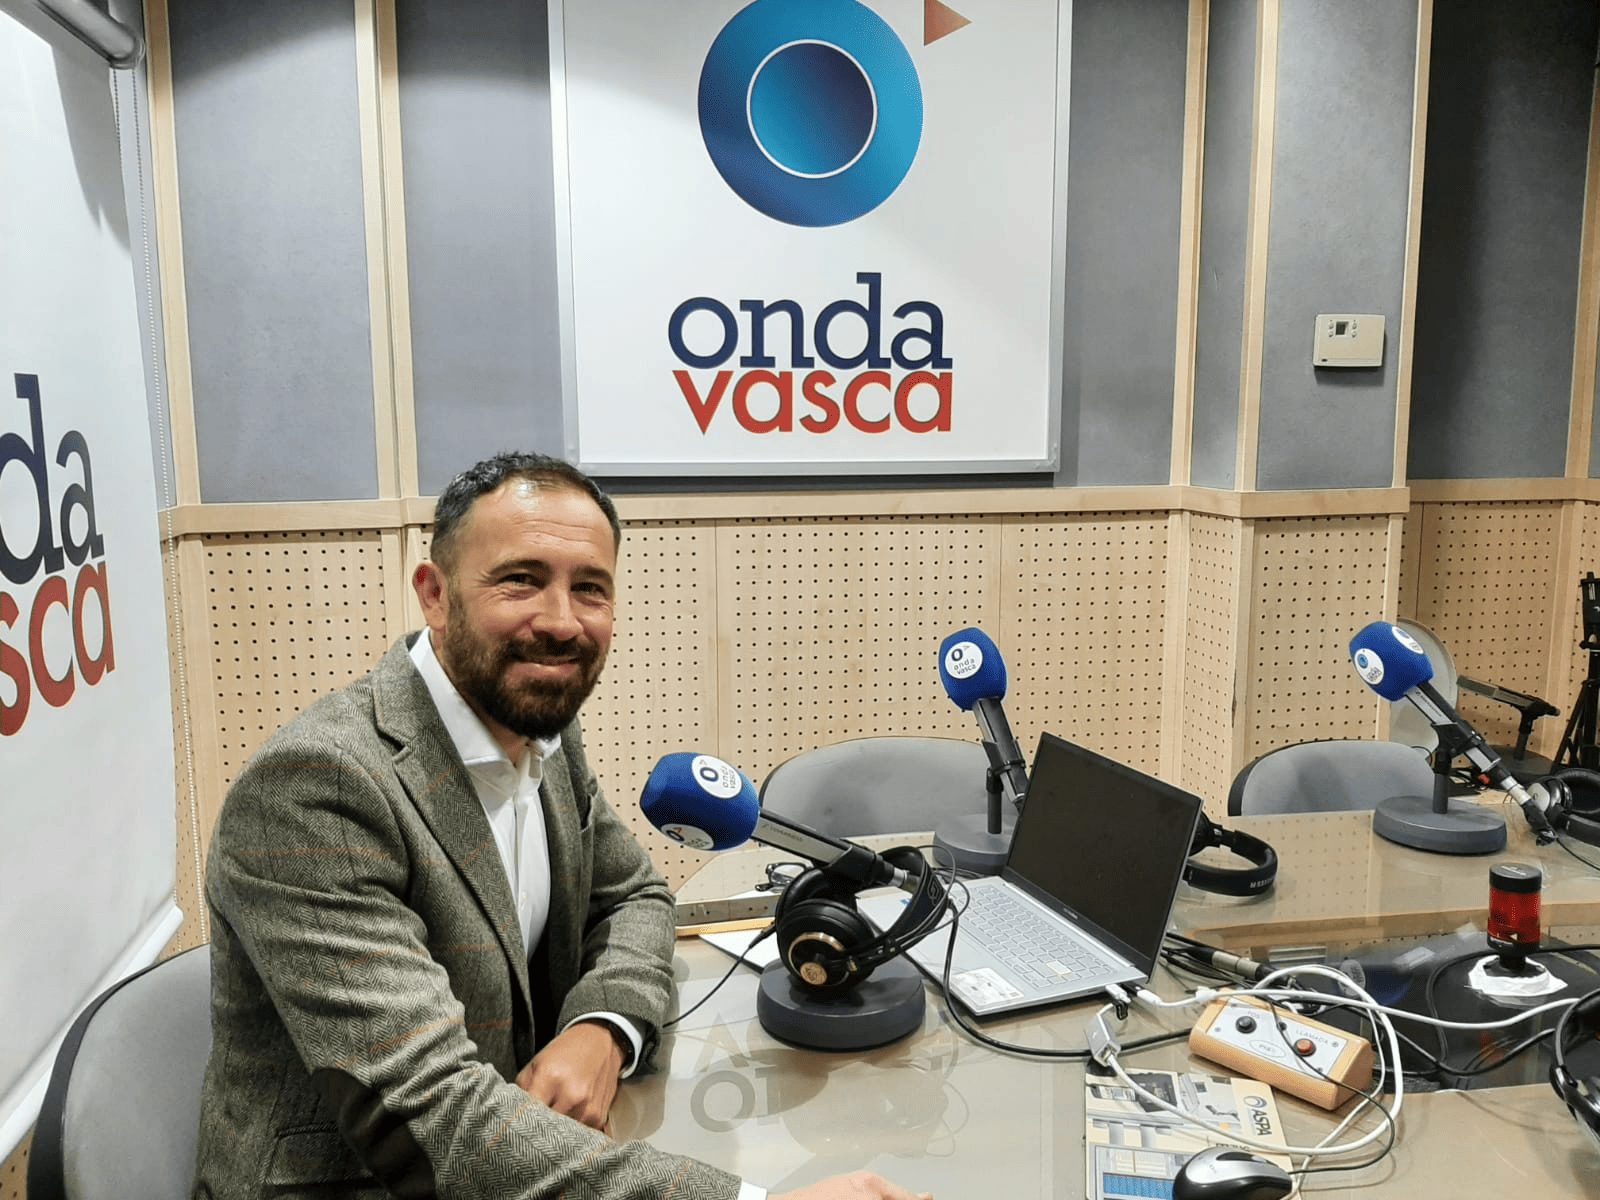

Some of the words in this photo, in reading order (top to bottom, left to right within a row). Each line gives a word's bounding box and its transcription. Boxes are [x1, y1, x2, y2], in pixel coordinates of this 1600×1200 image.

[667, 271, 953, 370] onda
[671, 369, 953, 435] vasca
[1252, 1108, 1273, 1136] ASPA
